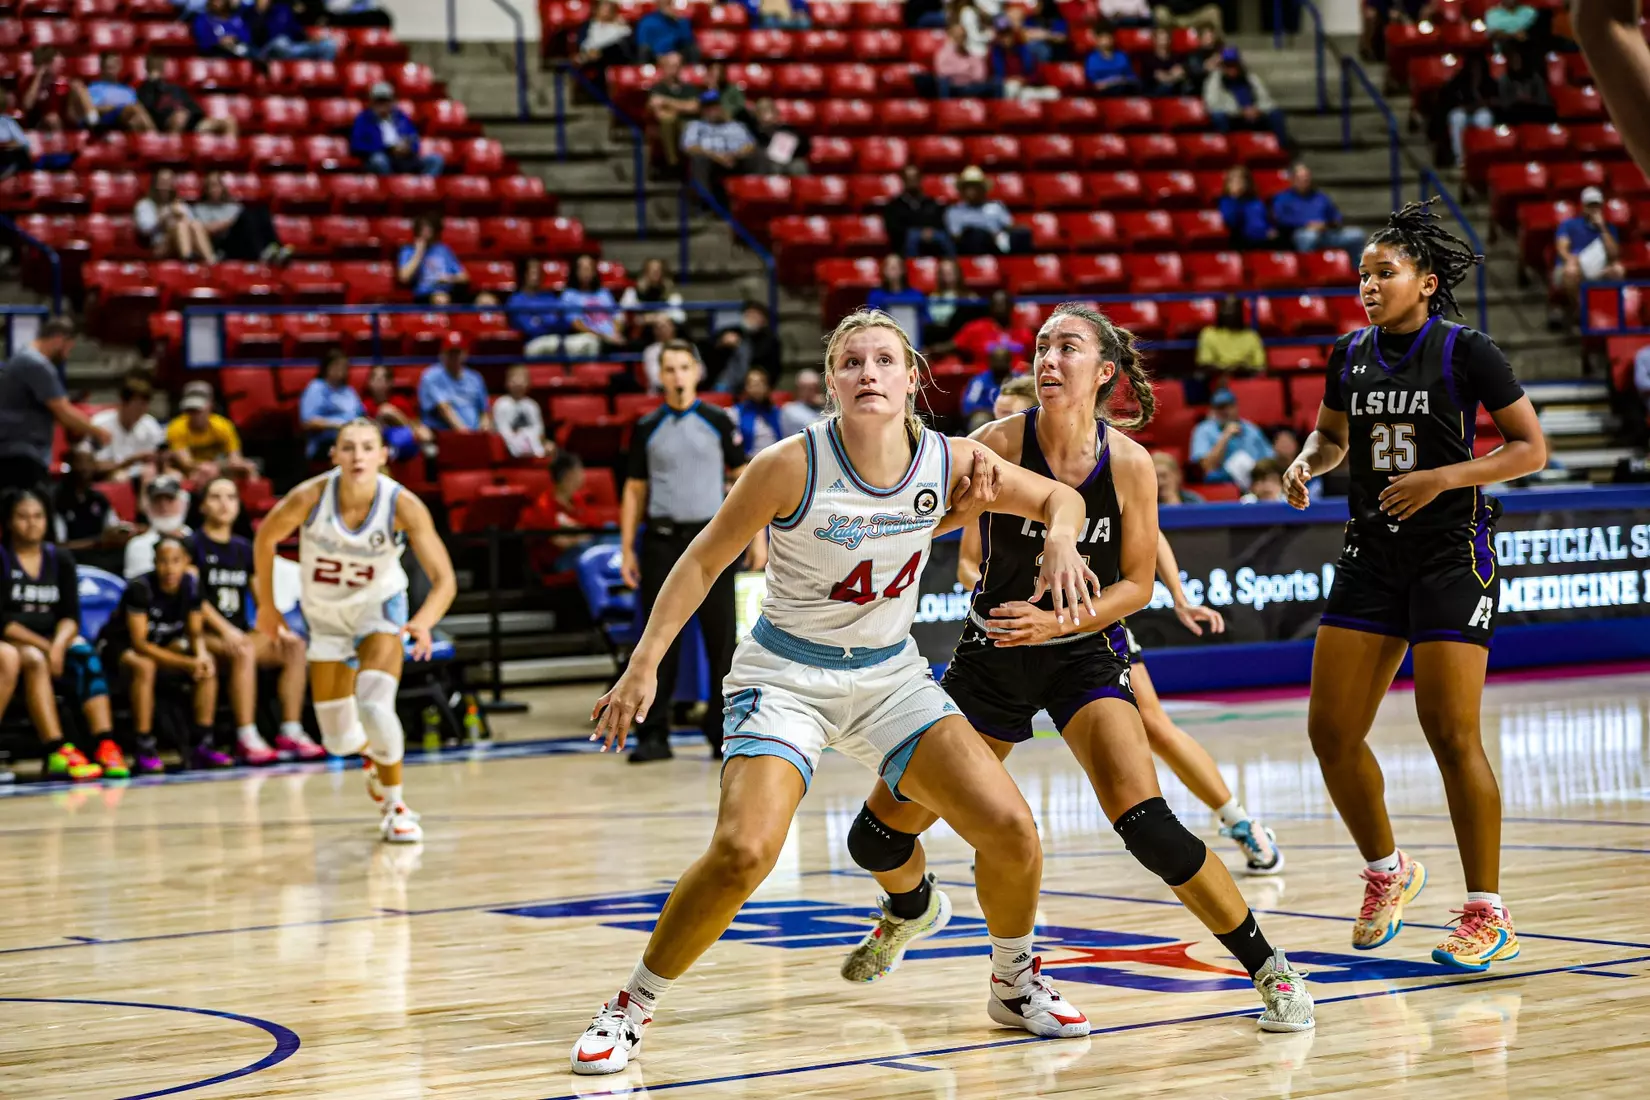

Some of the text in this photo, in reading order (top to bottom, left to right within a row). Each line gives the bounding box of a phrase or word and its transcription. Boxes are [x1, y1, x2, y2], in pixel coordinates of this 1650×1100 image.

[1351, 391, 1430, 416] LSUA
[1370, 422, 1418, 472] 25
[814, 514, 867, 550] Lady
[1494, 524, 1650, 567] OFFICIAL S
[313, 557, 375, 588] 23
[829, 550, 922, 606] 44
[1207, 567, 1234, 606] &
[1235, 566, 1320, 611] Sports
[1498, 570, 1640, 613] MEDICINE
